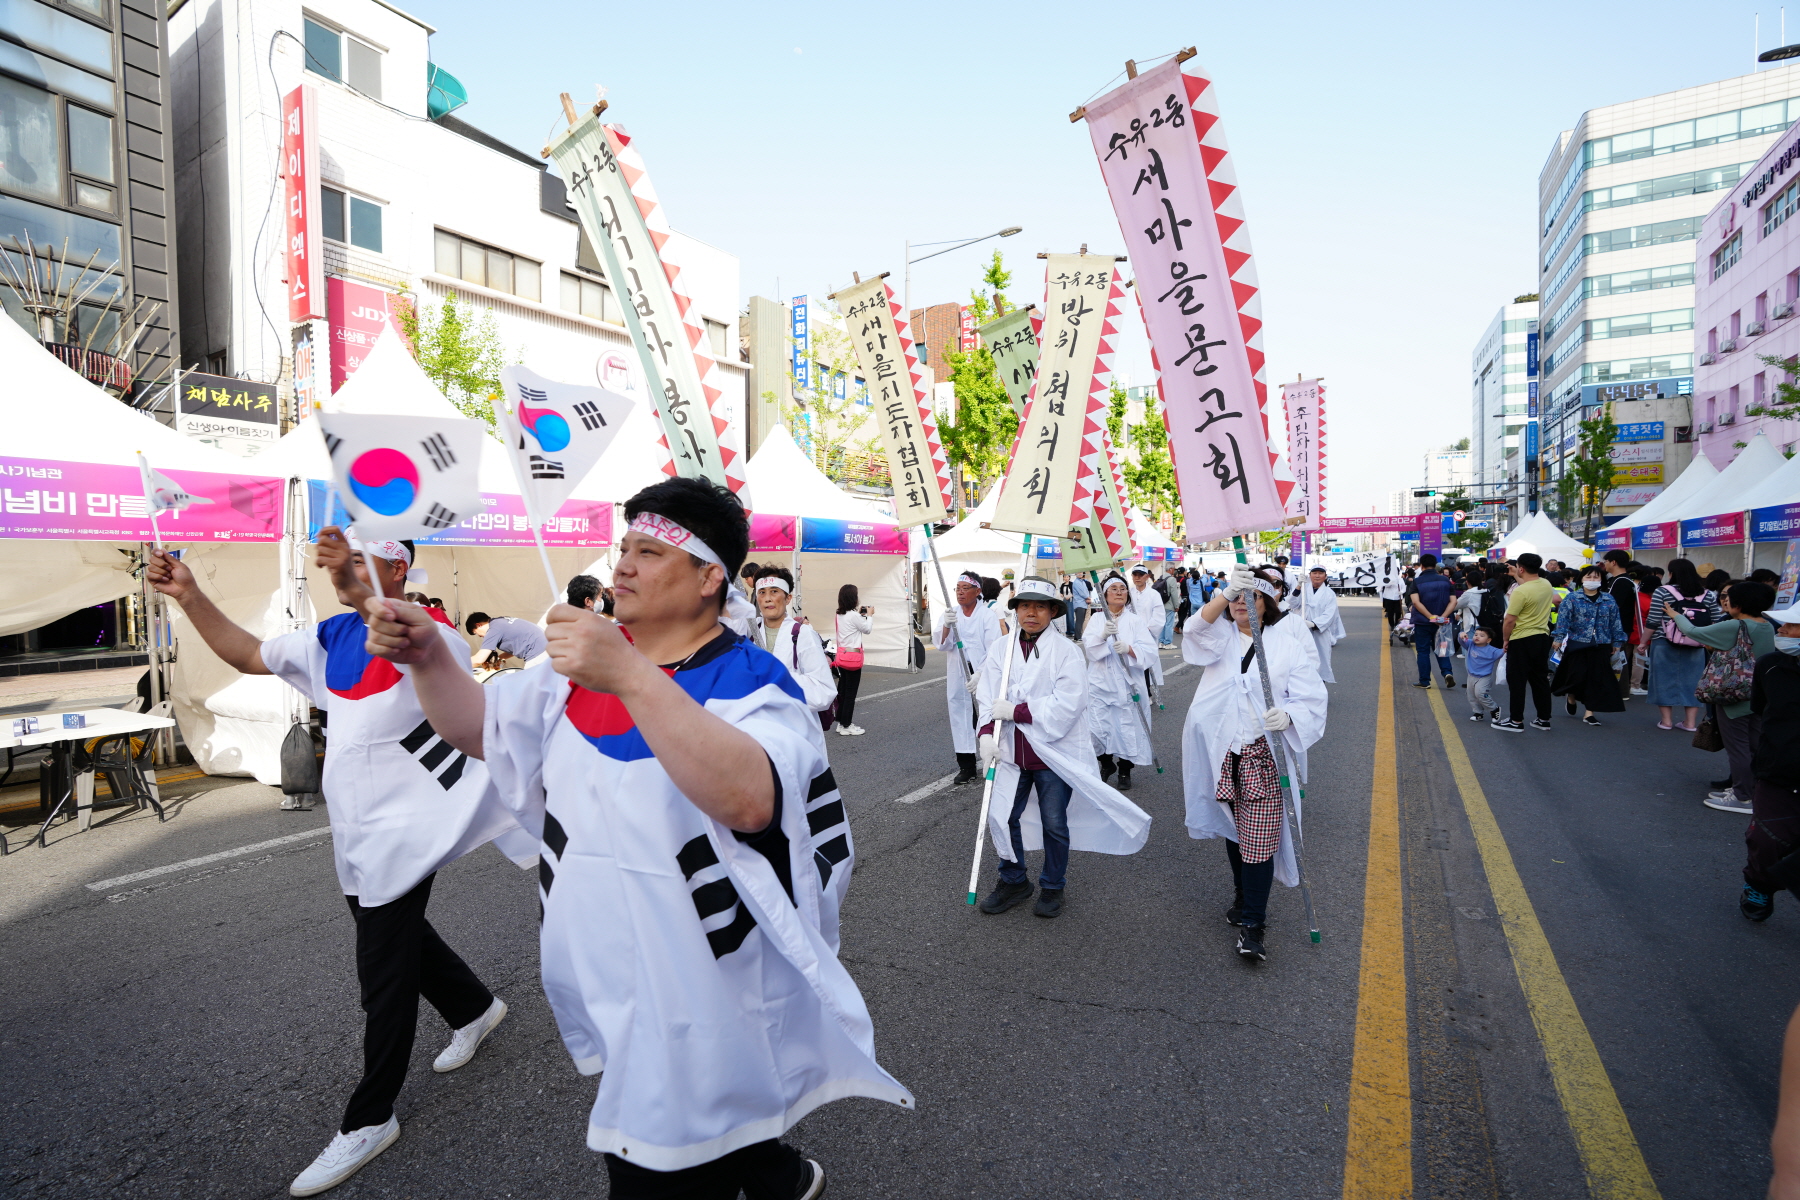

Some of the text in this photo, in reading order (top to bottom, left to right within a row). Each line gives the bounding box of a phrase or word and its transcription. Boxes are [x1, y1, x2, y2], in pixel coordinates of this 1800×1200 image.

[1104, 94, 1187, 163] 수유2동
[287, 105, 306, 301] 제이디엑스
[1048, 271, 1109, 290] 수유2동
[351, 306, 393, 323] JDX
[846, 291, 886, 319] 수유2동
[1132, 148, 1251, 505] 새마을문고회
[990, 326, 1035, 357] 수유2동
[862, 315, 931, 508] 새마을지도자협의회
[1023, 295, 1094, 514] 방위협의회
[1629, 423, 1663, 435] 주짓수
[1622, 447, 1640, 457] 스시
[1629, 466, 1661, 477] 순대국
[0, 488, 76, 516] 념비
[1615, 491, 1657, 503] 노래방
[545, 518, 590, 534] 만들자!
[1320, 518, 1348, 527] ·19혁명
[1348, 517, 1390, 527] 국민문화제
[1390, 516, 1417, 525] 2024
